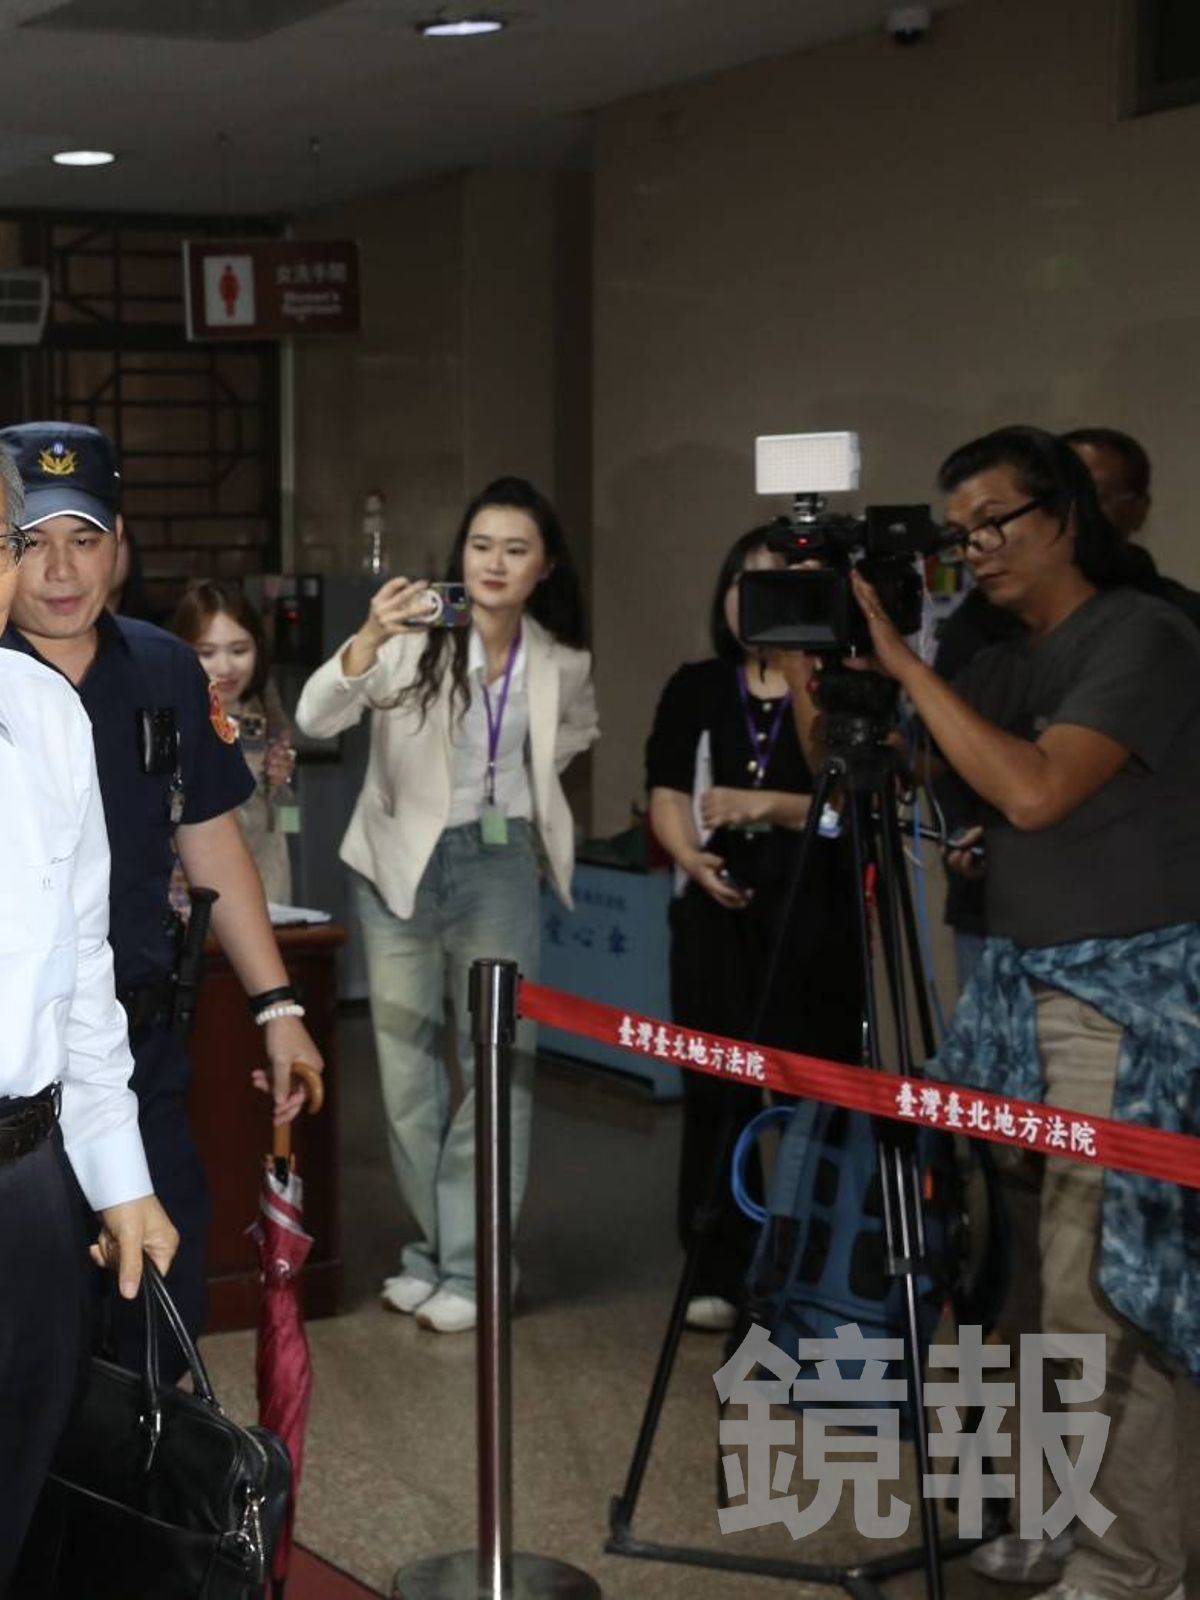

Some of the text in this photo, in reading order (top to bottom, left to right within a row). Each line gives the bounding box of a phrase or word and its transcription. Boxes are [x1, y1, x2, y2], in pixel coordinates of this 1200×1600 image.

[618, 1014, 766, 1081] 臺灣臺北地方法院
[895, 1081, 1097, 1156] 臺灣臺北地方法院
